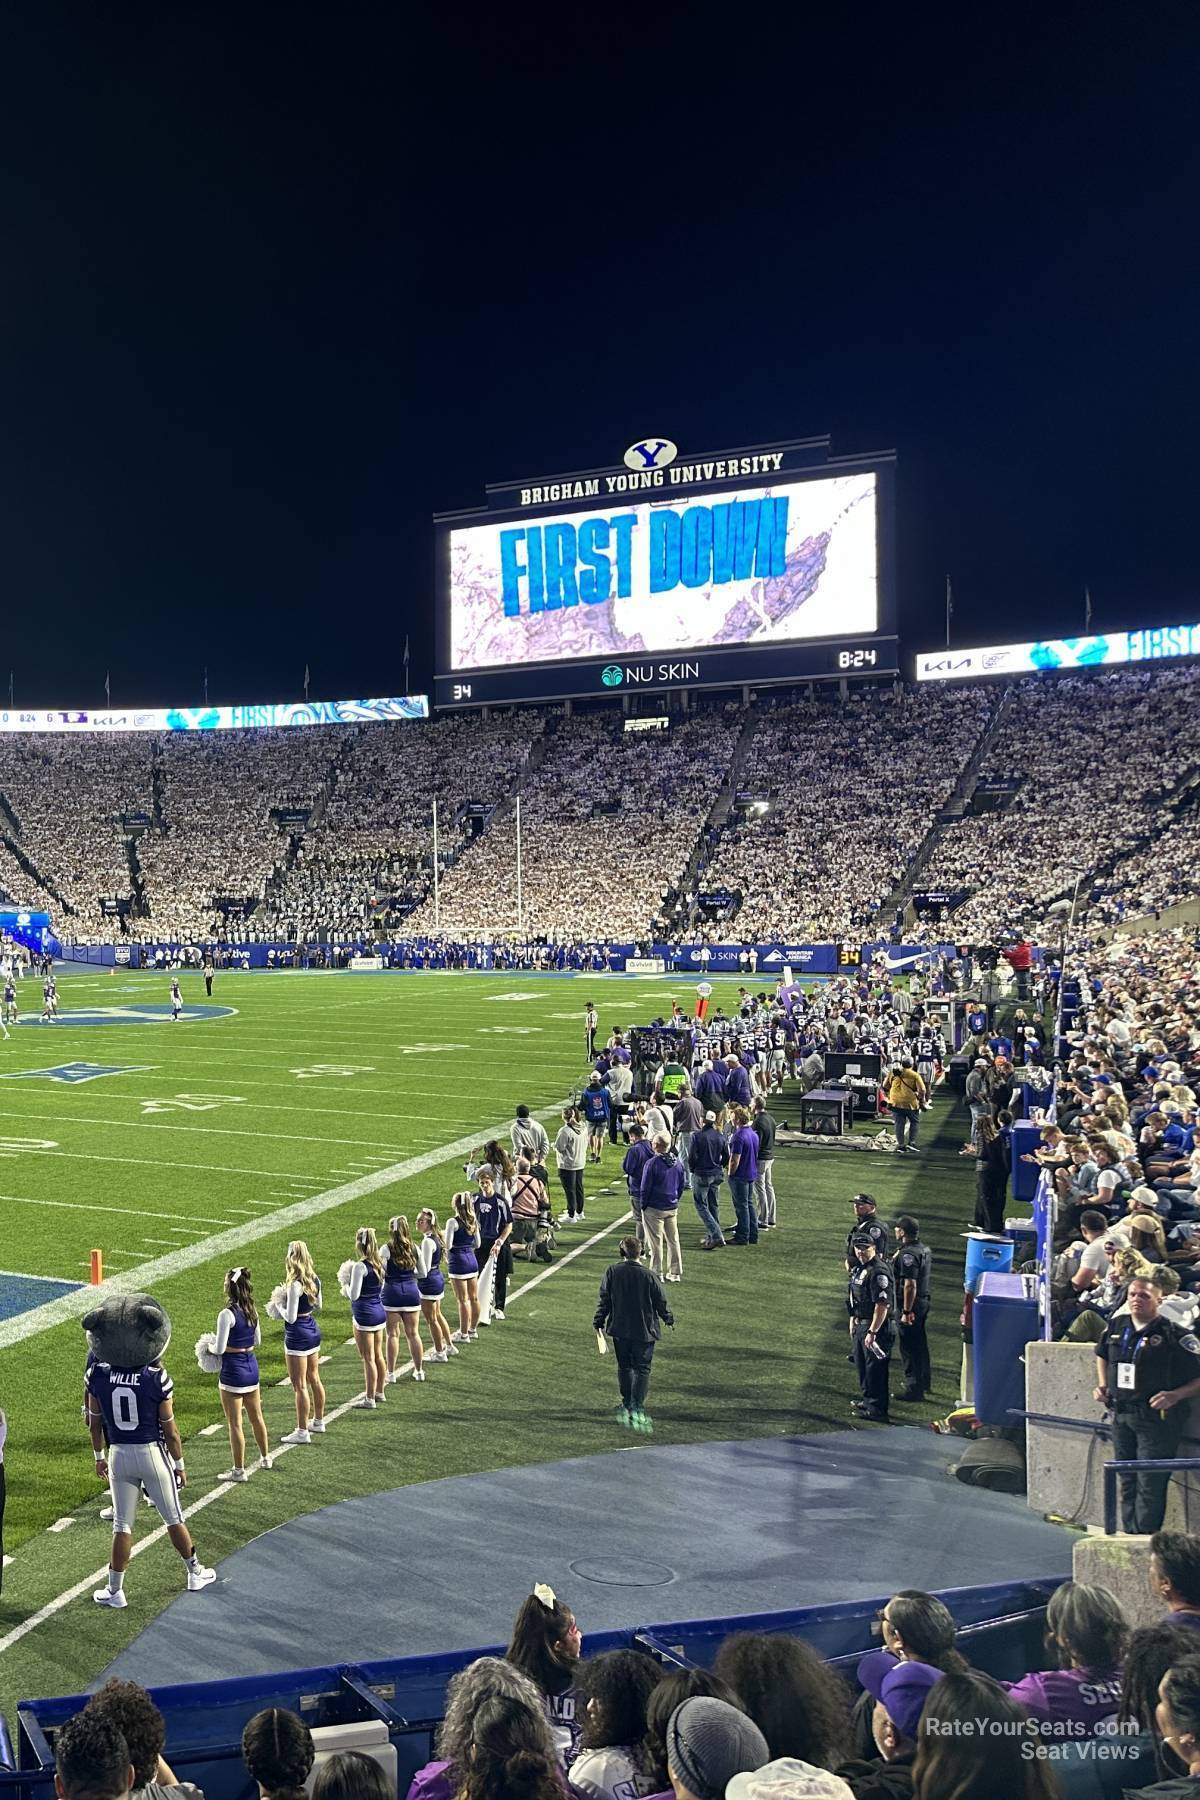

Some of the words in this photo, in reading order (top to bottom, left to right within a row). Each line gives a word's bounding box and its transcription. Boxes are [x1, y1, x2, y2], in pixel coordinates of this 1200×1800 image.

[521, 479, 600, 506] BRIGHAM
[605, 467, 665, 491] YOUNG
[669, 452, 785, 484] UNIVERSITY
[499, 513, 638, 618] FIRST
[648, 495, 790, 594] DOWN
[838, 649, 877, 668] 8:24
[625, 666, 654, 683] NU
[658, 662, 699, 681] SKIN
[453, 684, 472, 700] 34
[20, 714, 36, 722] 8:24
[624, 717, 669, 732] ESPN
[718, 952, 738, 960] SKIN
[840, 951, 859, 964] 34
[918, 1042, 934, 1056] 12
[140, 1094, 248, 1114] 20
[110, 1372, 141, 1386] WILLIE
[112, 1387, 138, 1431] 0
